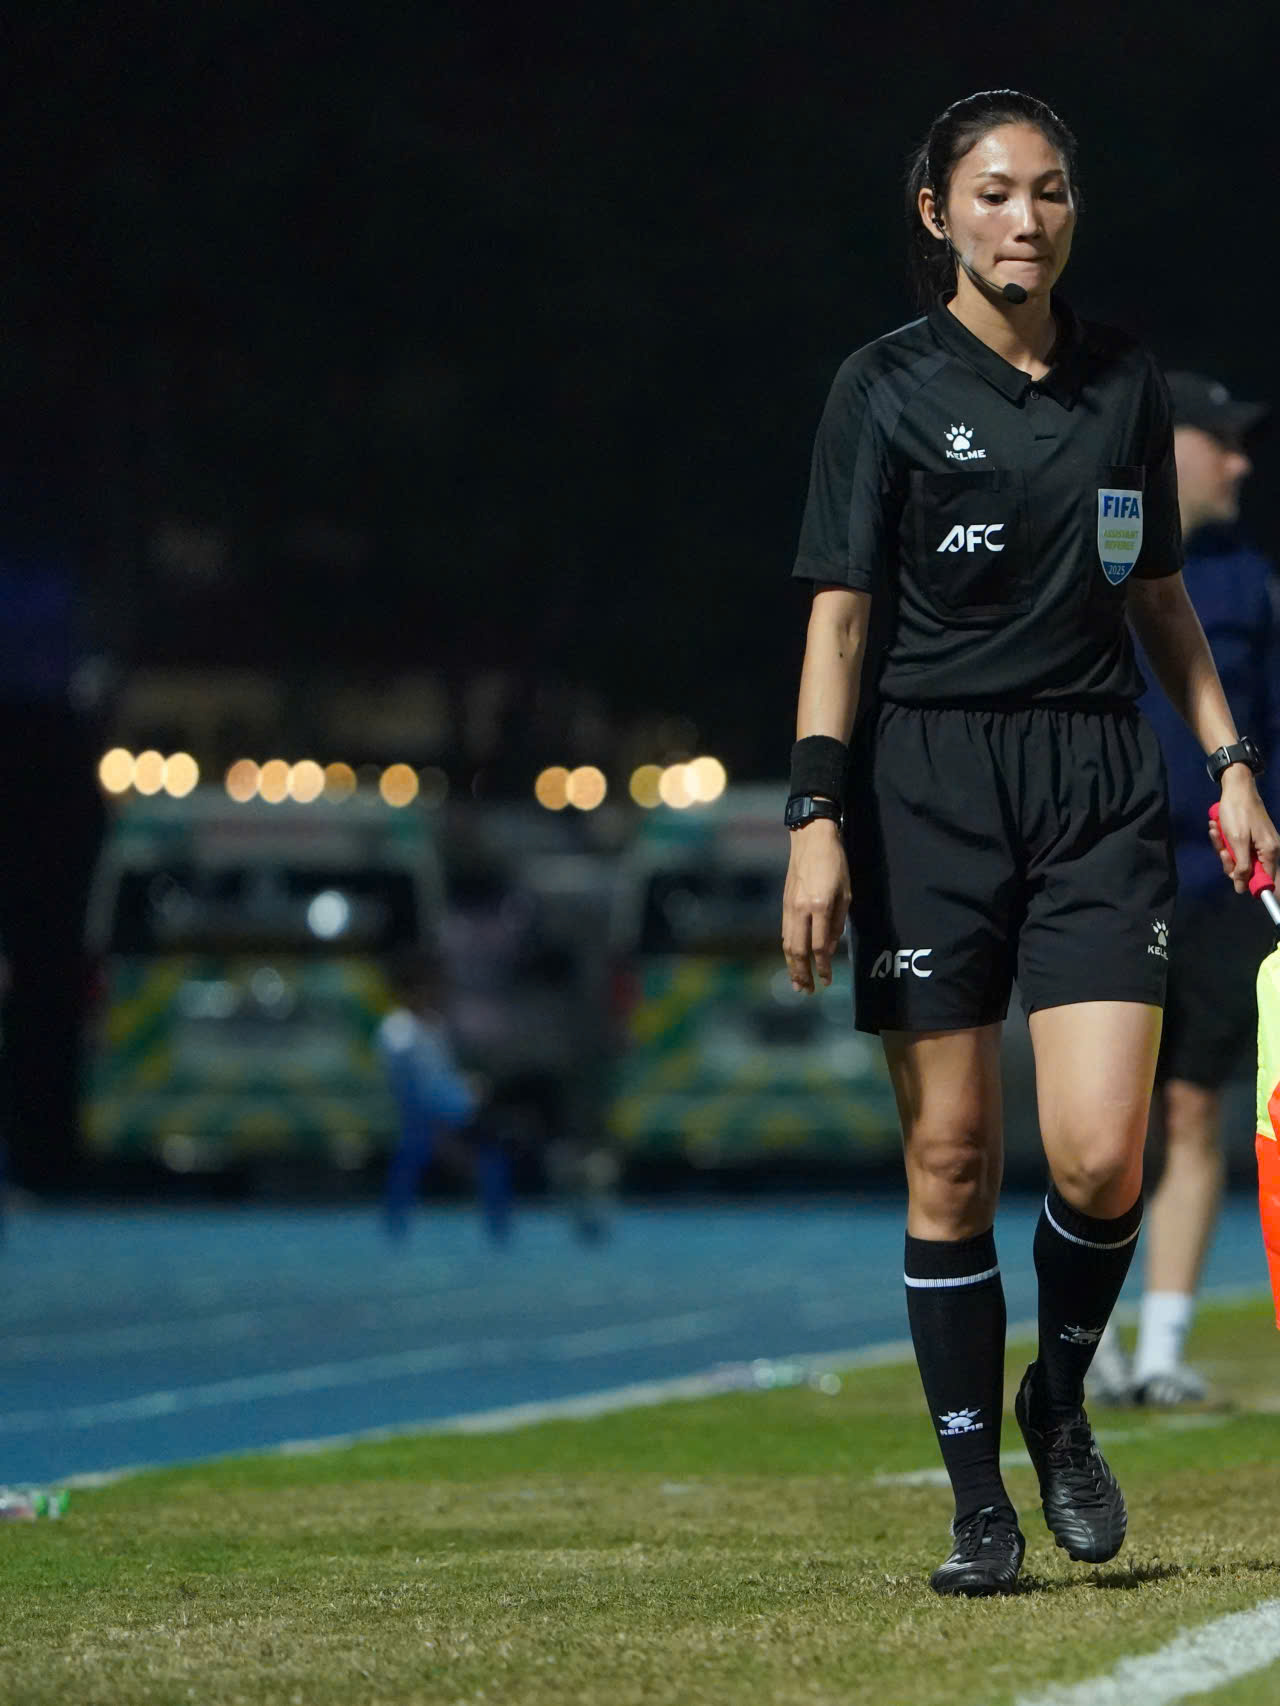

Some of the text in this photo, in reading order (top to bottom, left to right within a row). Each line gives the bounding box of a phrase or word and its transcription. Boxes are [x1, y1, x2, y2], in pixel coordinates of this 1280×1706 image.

[946, 449, 987, 461] KELME
[1103, 495, 1140, 519] FIFA
[936, 523, 1005, 553] AFC
[1108, 565, 1126, 576] 2025
[870, 948, 933, 978] AFC
[940, 1422, 984, 1436] KELME
